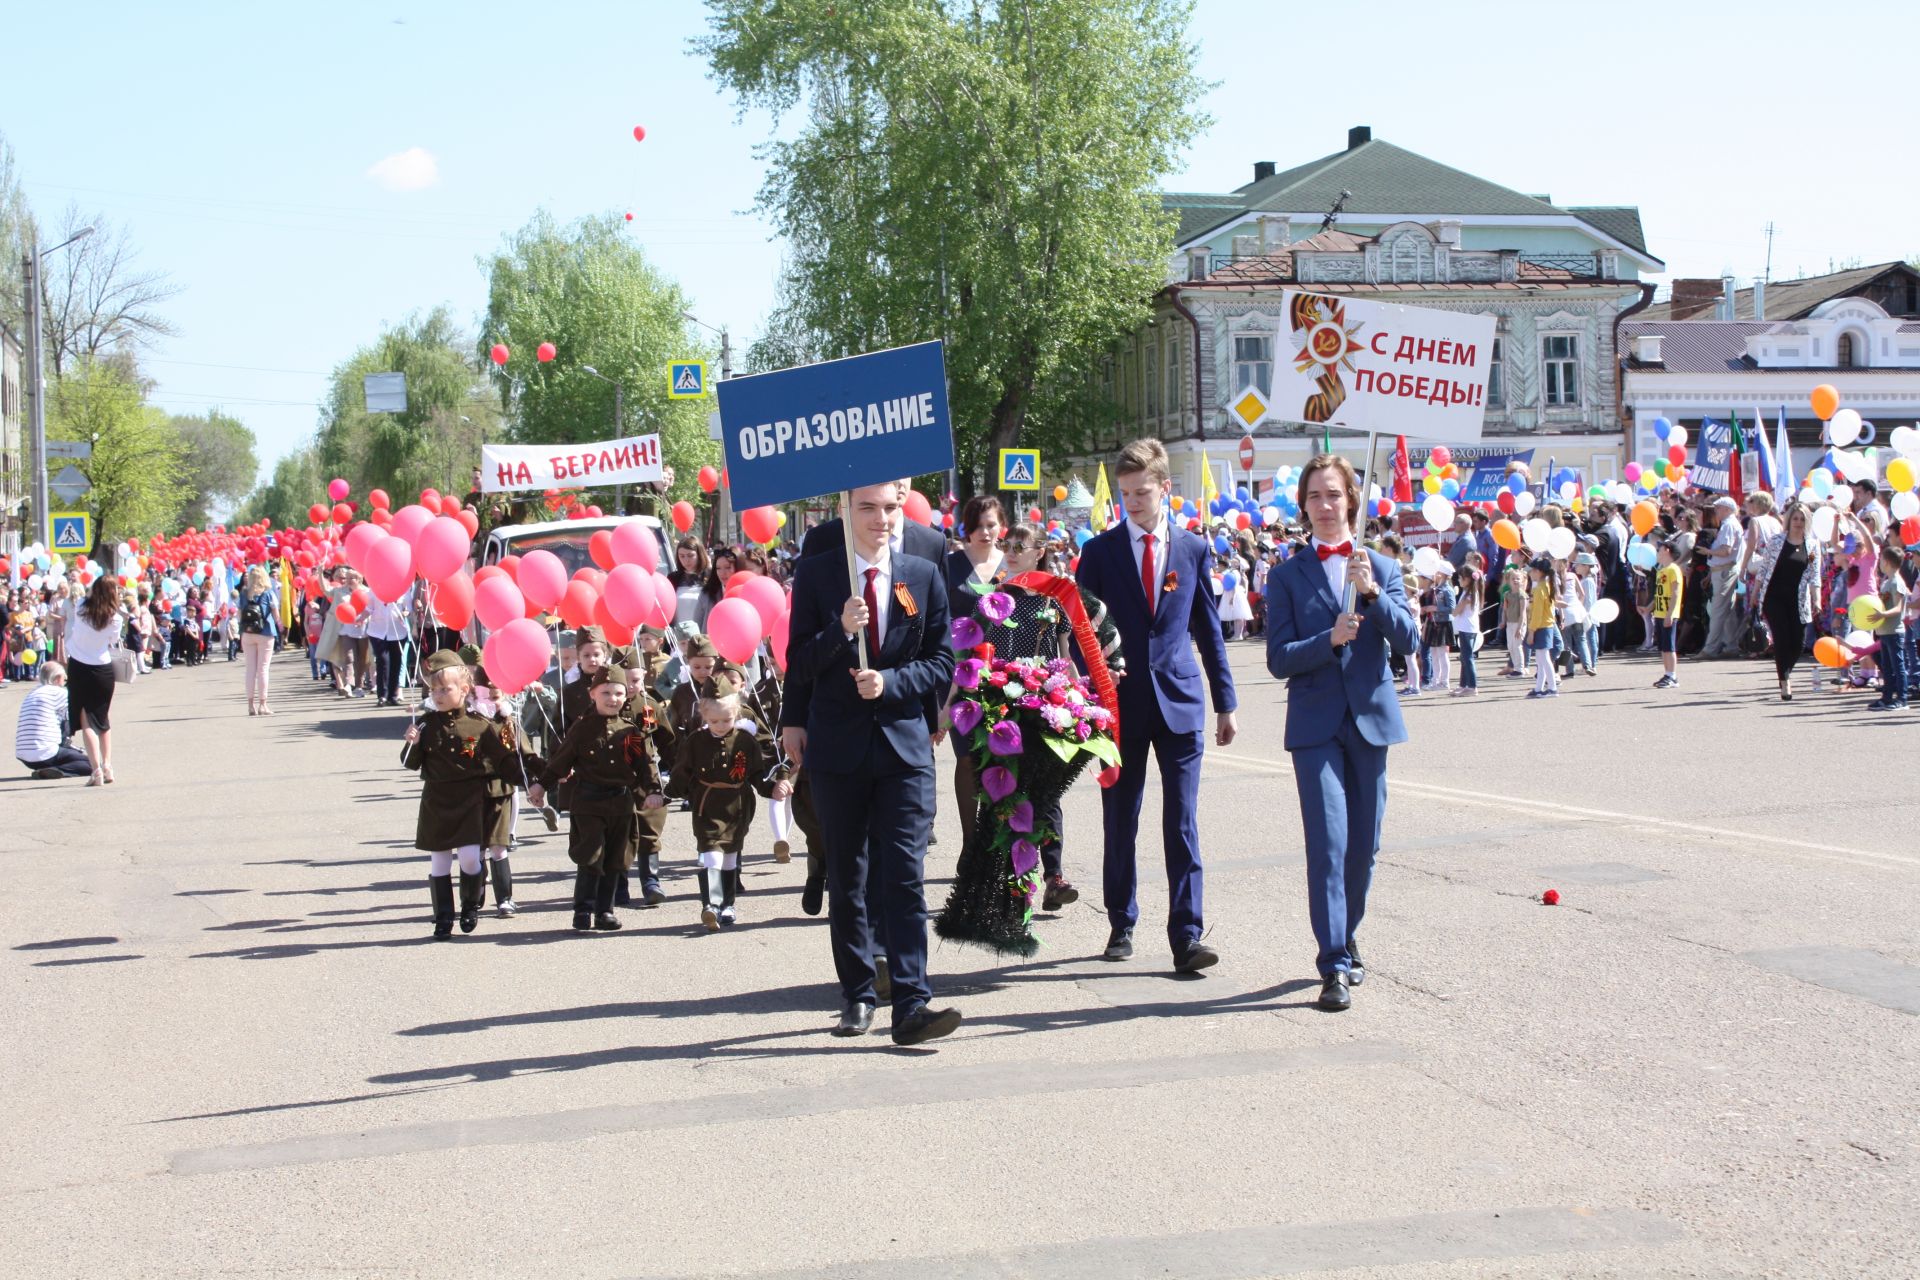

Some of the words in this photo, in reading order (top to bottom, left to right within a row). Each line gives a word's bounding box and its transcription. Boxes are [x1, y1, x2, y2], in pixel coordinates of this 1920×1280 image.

[1371, 332, 1389, 355] С
[1394, 335, 1476, 367] ДНЁМ
[1355, 369, 1483, 407] ПОБЕДЫ!
[738, 391, 936, 461] ОБРАЗОВАНИЕ
[496, 460, 533, 487] НА
[549, 438, 658, 481] БЕРЛИН!
